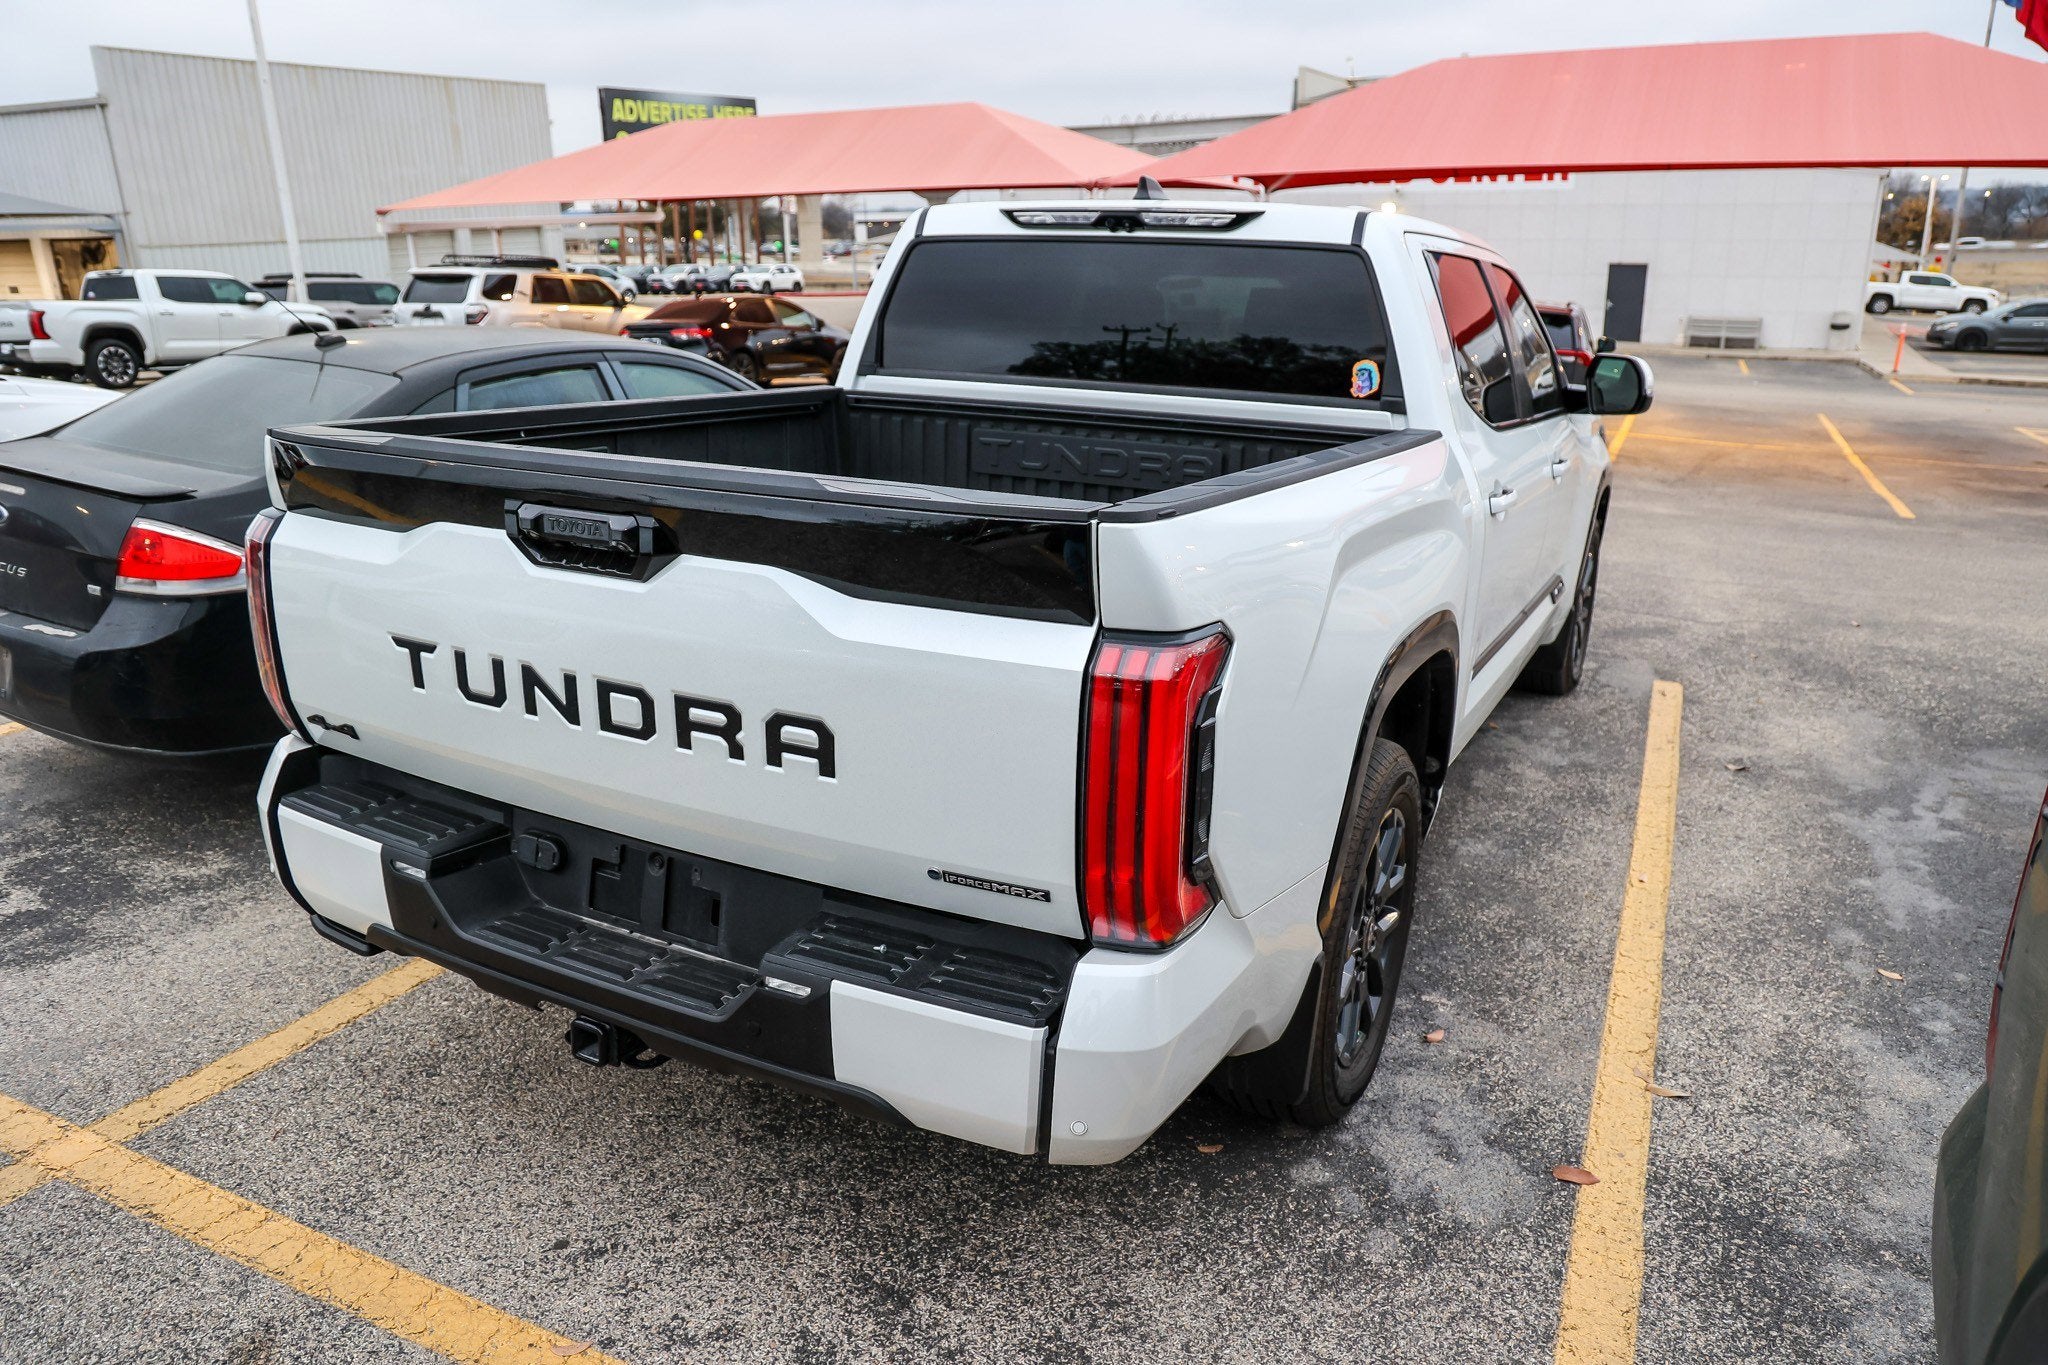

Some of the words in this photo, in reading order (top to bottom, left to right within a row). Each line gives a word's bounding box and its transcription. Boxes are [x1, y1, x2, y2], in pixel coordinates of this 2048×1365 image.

[612, 97, 707, 123] ADVERTISE
[979, 437, 1213, 483] TUNDRA
[549, 517, 603, 537] TOYOTA
[390, 633, 836, 781] TUNDRA
